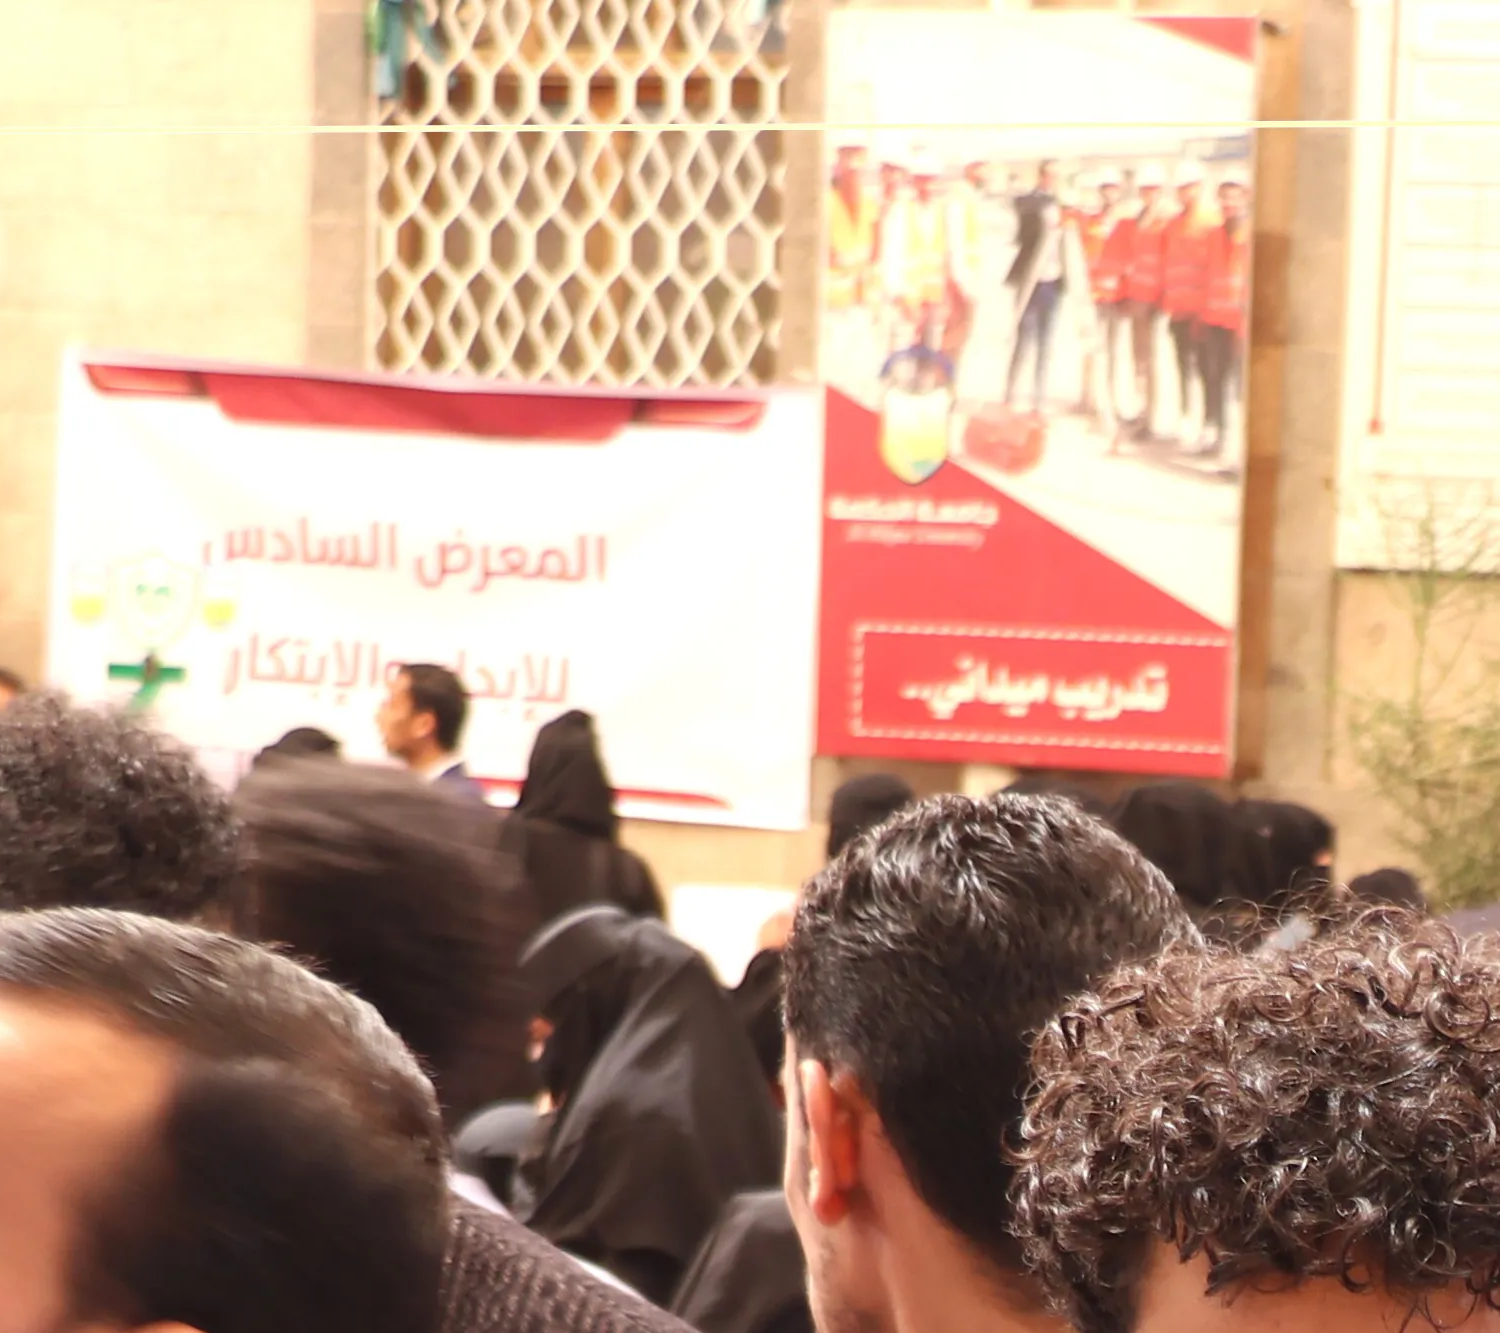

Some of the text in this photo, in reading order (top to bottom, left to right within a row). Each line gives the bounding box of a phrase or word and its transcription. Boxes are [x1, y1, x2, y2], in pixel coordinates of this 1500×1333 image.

[414, 528, 607, 594] المعرض
[435, 650, 570, 721] للإبدا
[1052, 661, 1169, 721] تدريب
